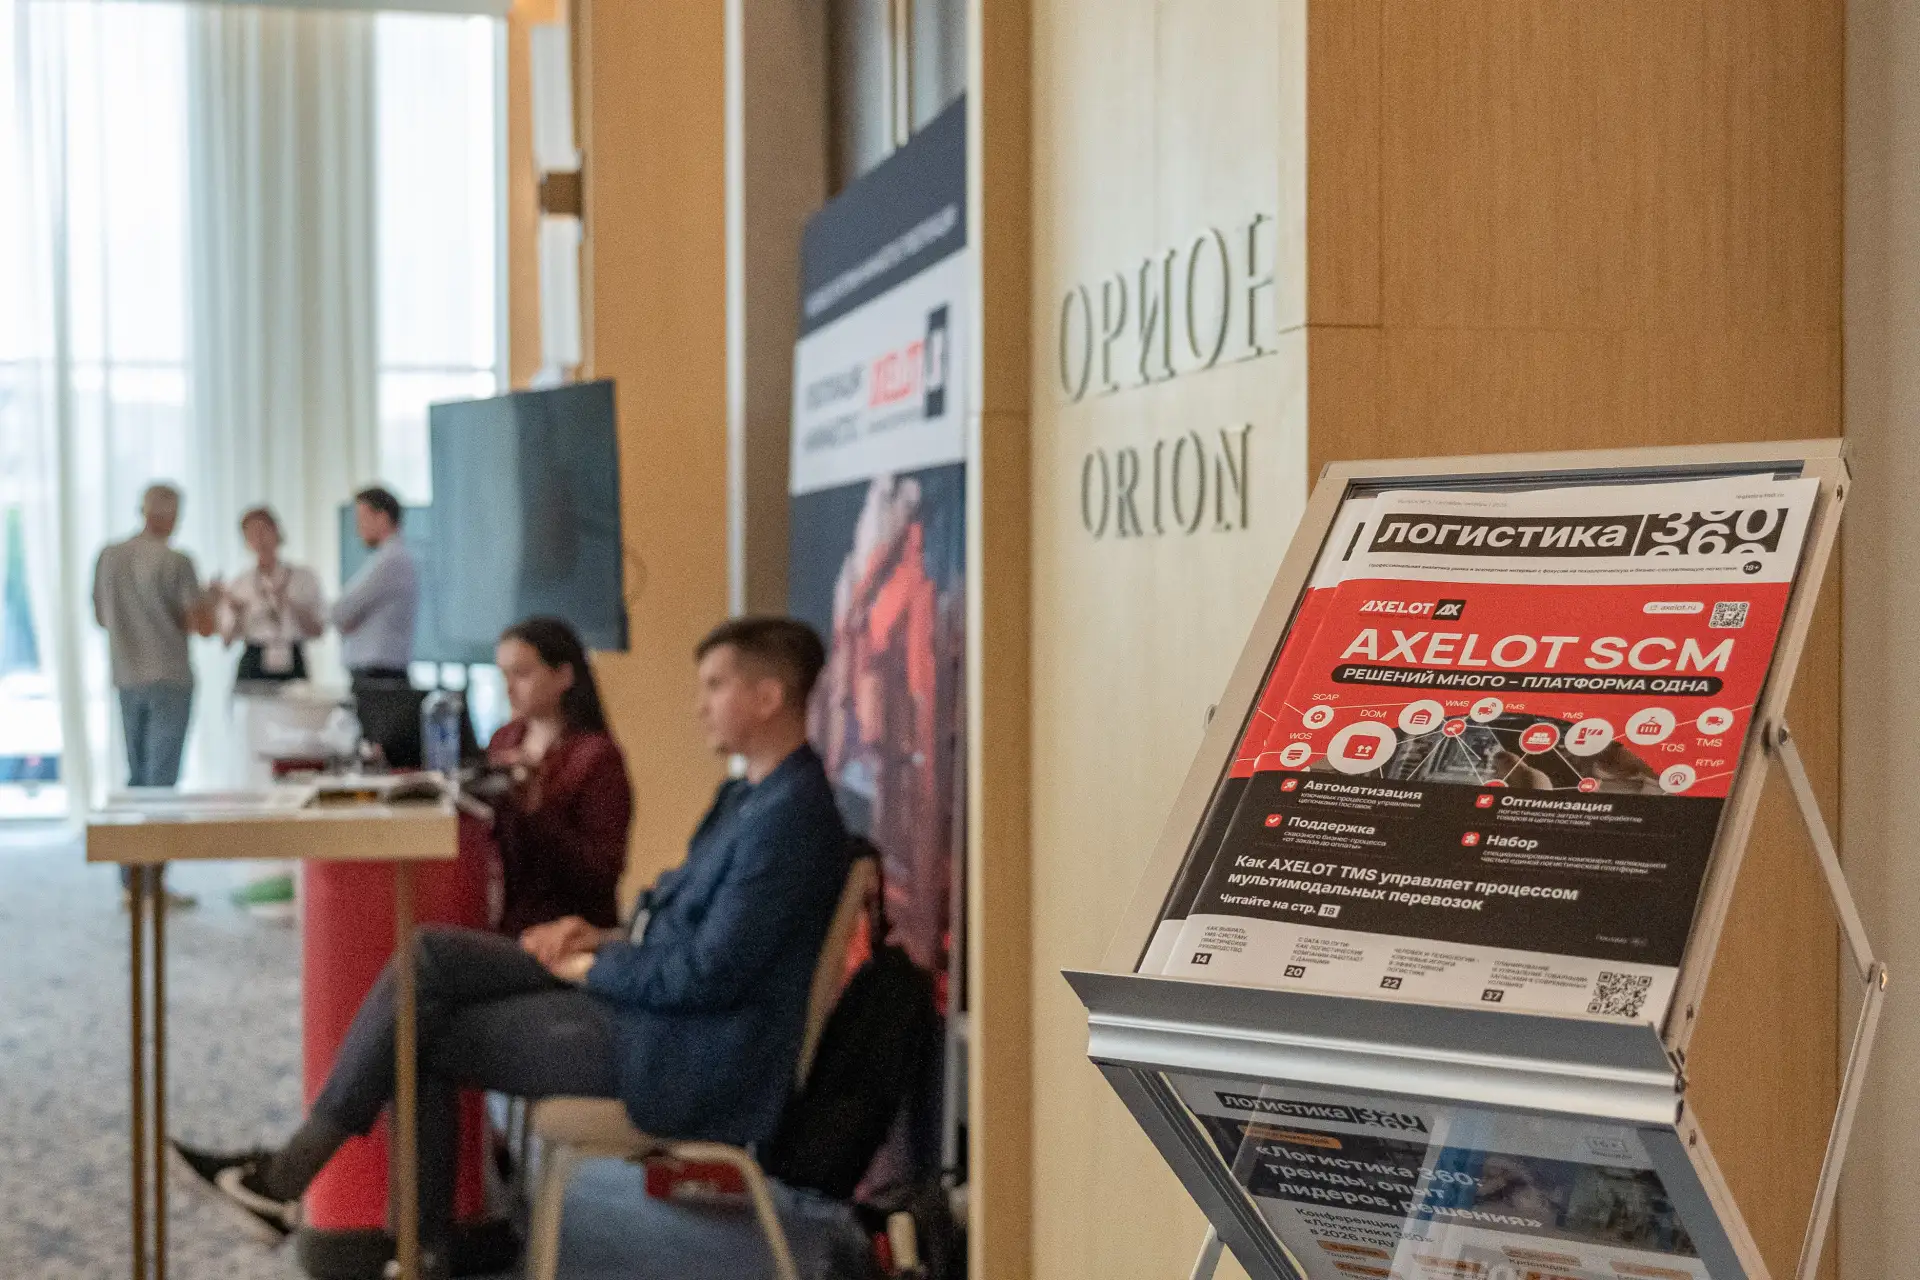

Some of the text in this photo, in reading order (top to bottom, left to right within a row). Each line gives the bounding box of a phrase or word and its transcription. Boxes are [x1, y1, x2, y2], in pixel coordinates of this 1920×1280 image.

[1081, 423, 1252, 540] ORION
[1378, 522, 1628, 549] логистика
[1744, 563, 1760, 573] 18+
[1360, 600, 1434, 615] AXELOT
[1659, 603, 1697, 612] axelot.ru
[1340, 628, 1735, 672] AXELOT SCM
[1343, 667, 1435, 684] РЕШЕНИЙ
[1436, 673, 1505, 687] МНОГО
[1522, 676, 1645, 690] ПЛАТФОРМА
[1650, 679, 1709, 693] ОДНА
[1311, 693, 1339, 701] SCAP
[1445, 699, 1470, 708] WMS
[1360, 709, 1387, 719] DOM
[1289, 732, 1312, 740] WOS
[1696, 738, 1723, 748] TMS
[1660, 743, 1685, 753] TOS
[1304, 780, 1422, 800] Автоматизация
[1501, 796, 1613, 812] Оптимизация
[1288, 816, 1376, 835] Поддержка
[1486, 834, 1538, 850] Набор
[1235, 855, 1579, 900] Как AXELOT TMS управляет процессом
[1228, 873, 1484, 911] мультимодальных перевозок
[1220, 893, 1336, 916] Читайте на стр. 18
[1195, 954, 1209, 964] 14
[1285, 966, 1303, 977] 20
[1382, 978, 1400, 988] 22
[1484, 990, 1501, 1000] 37
[1255, 1145, 1414, 1179] «Логистика
[1264, 1163, 1445, 1200] тренды, опыт
[1278, 1182, 1543, 1228] лидеров, решения»
[1295, 1207, 1400, 1230] Конференции
[1361, 1236, 1395, 1249] году
